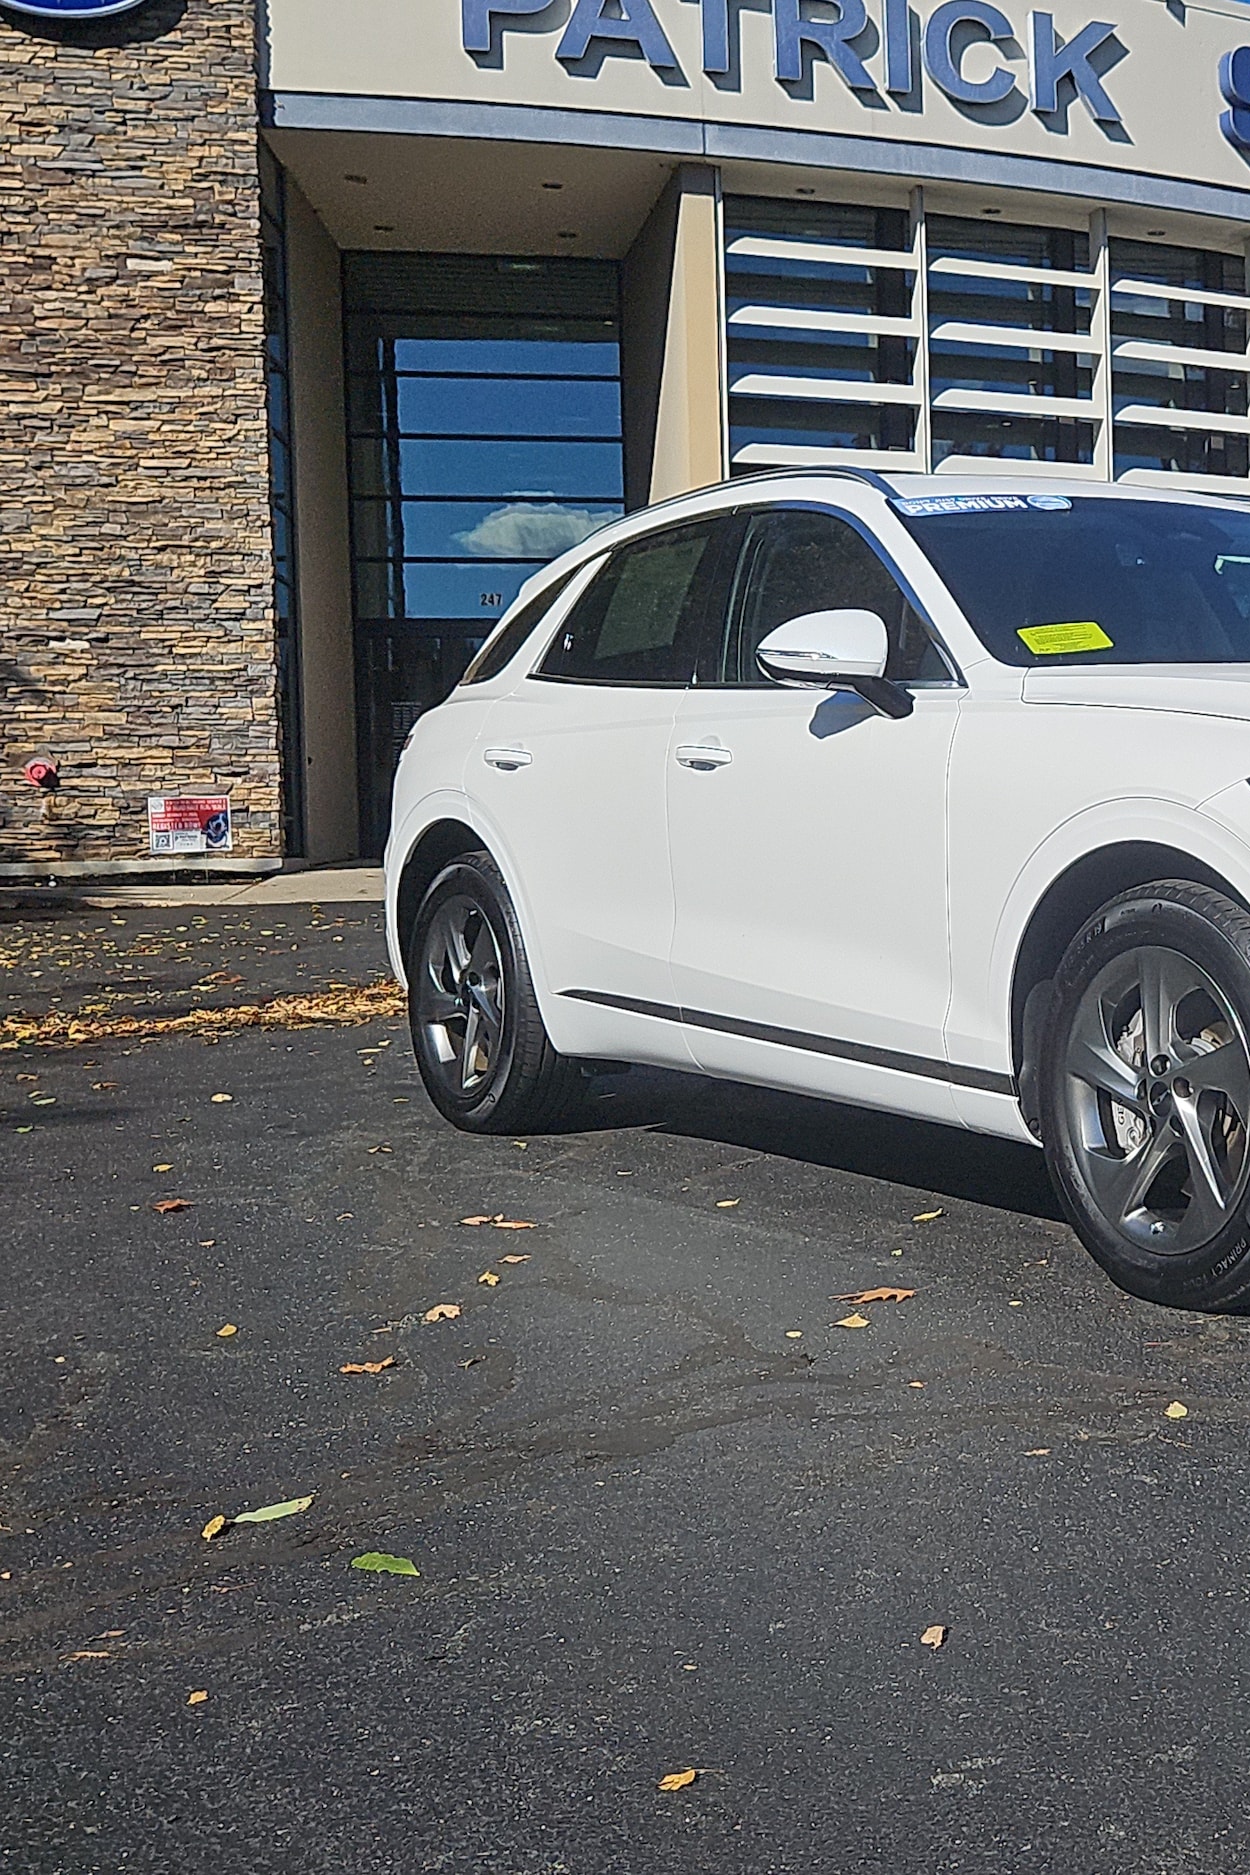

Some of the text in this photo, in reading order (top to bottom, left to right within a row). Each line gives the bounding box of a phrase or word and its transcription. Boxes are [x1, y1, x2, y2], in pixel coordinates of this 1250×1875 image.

[461, 0, 1122, 121] PATRICK
[905, 496, 1028, 514] PREMIUM
[480, 593, 502, 606] 247
